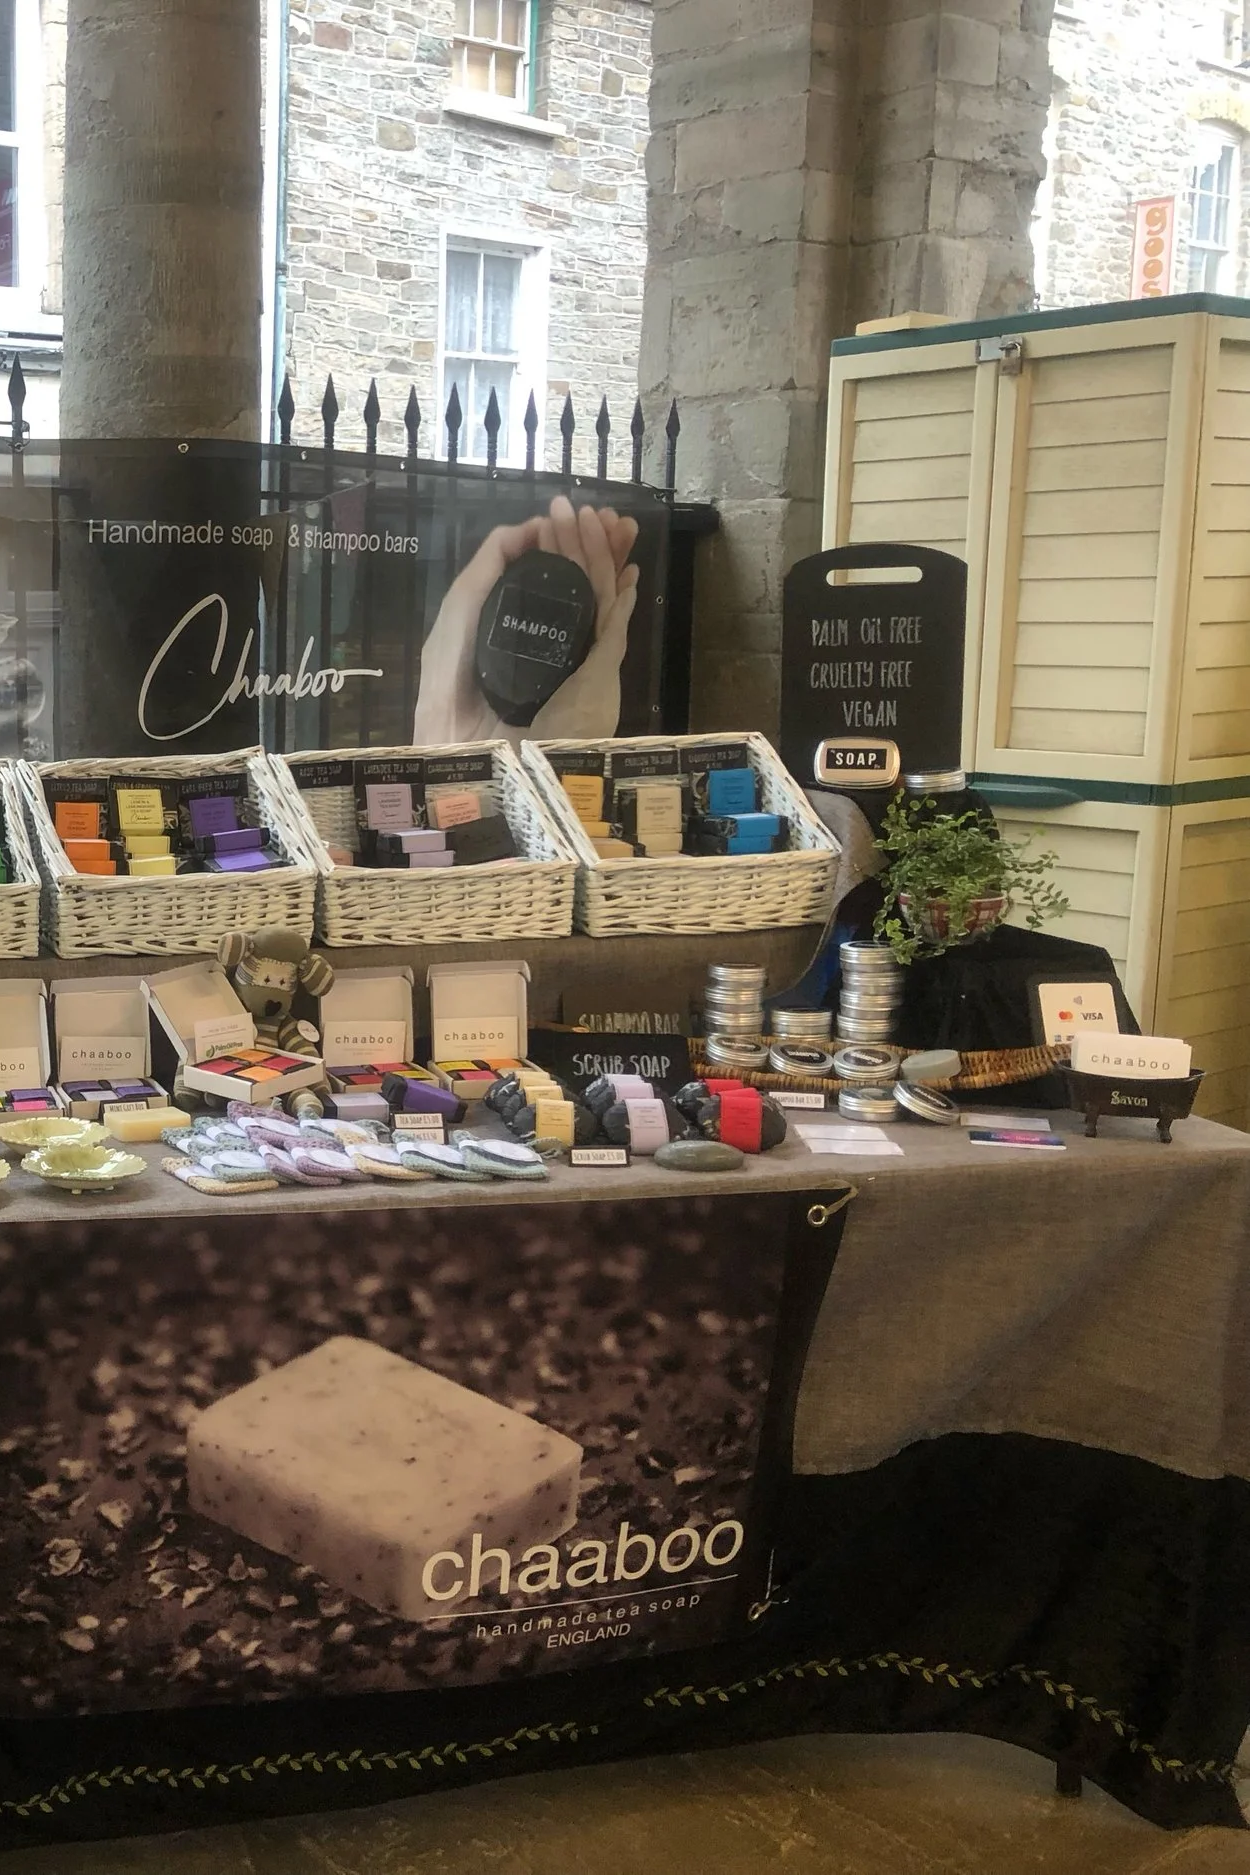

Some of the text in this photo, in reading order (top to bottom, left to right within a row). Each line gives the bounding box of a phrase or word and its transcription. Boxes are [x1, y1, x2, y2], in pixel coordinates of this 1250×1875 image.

[88, 519, 419, 556] Handmade soap & shampoo bars
[502, 615, 568, 642] SHAMPOO
[811, 619, 849, 647] PALM
[889, 616, 923, 644] FREE
[138, 593, 383, 740] Chaaboo
[810, 661, 913, 689] CRUELTY FREE
[843, 700, 898, 727] VEGAN
[835, 752, 877, 766] SOAP
[1081, 1012, 1104, 1021] VISA
[335, 1034, 393, 1044] chaaboo
[444, 1031, 504, 1041] chaaboo
[72, 1049, 132, 1059] chaaboo
[573, 1054, 670, 1078] SCRUB SOAP
[1091, 1054, 1171, 1071] chaaboo
[1110, 1091, 1148, 1107] Savon
[421, 1519, 744, 1601] chaaboo
[476, 1592, 702, 1638] handmade tea soap
[546, 1622, 632, 1649] ENGLAND
